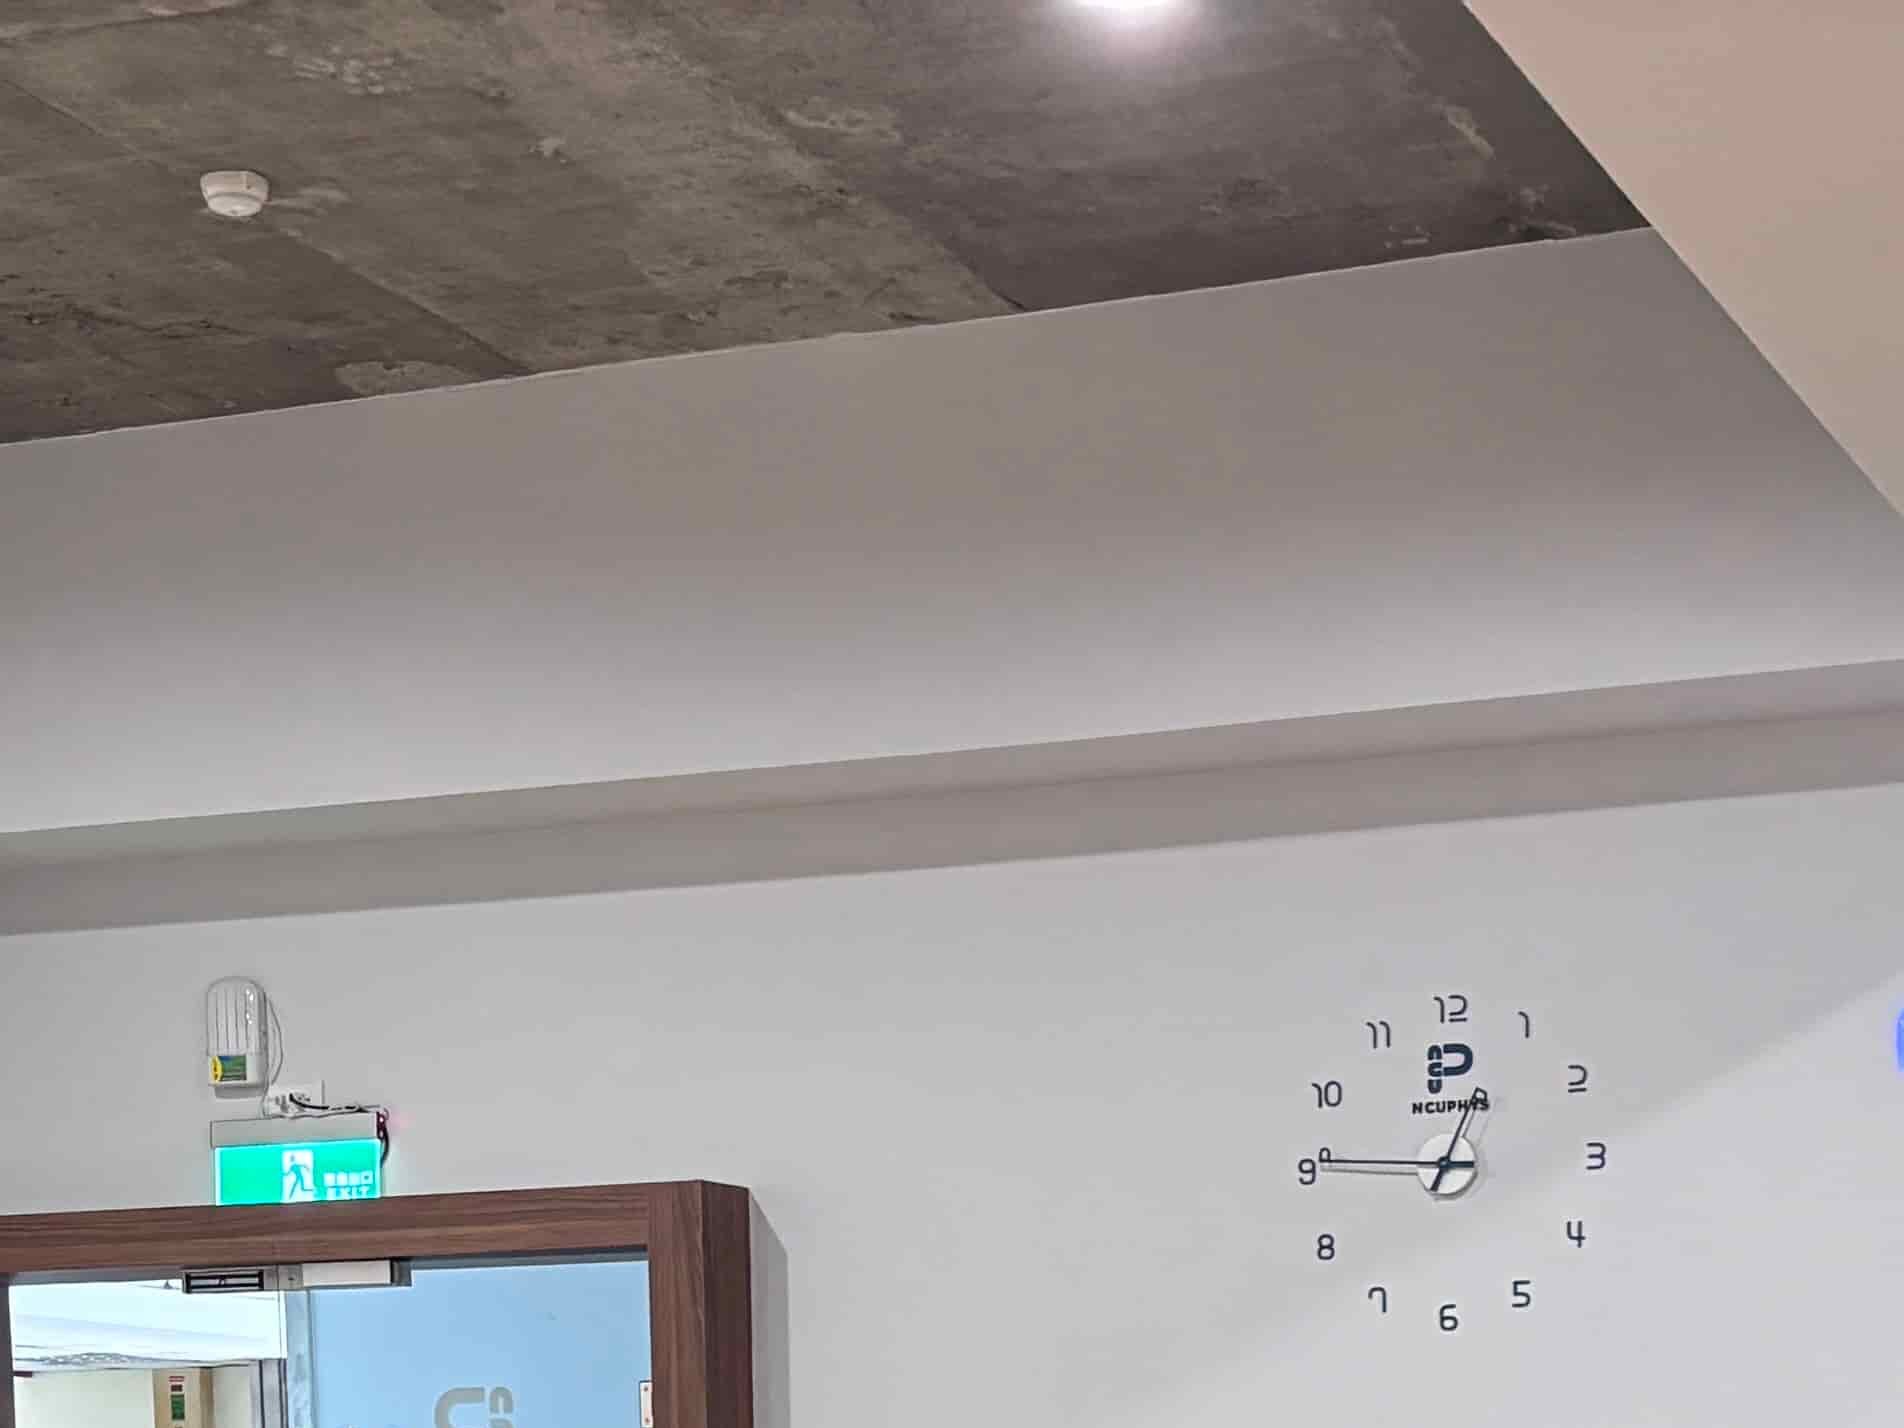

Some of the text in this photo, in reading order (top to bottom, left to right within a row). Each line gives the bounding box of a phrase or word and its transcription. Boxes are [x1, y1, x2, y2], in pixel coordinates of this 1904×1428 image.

[1433, 994, 1469, 1024] 12
[1365, 1020, 1392, 1050] 11
[1518, 1010, 1531, 1039] 1
[1567, 1064, 1589, 1094] 2
[1311, 1080, 1343, 1109] 10
[1586, 1141, 1608, 1170] 3
[1298, 1157, 1317, 1186] 9
[1317, 1232, 1336, 1261] 8
[1566, 1220, 1586, 1249] 4
[1368, 1285, 1388, 1314] 7
[1511, 1279, 1532, 1309] 5
[1438, 1303, 1459, 1332] 6
